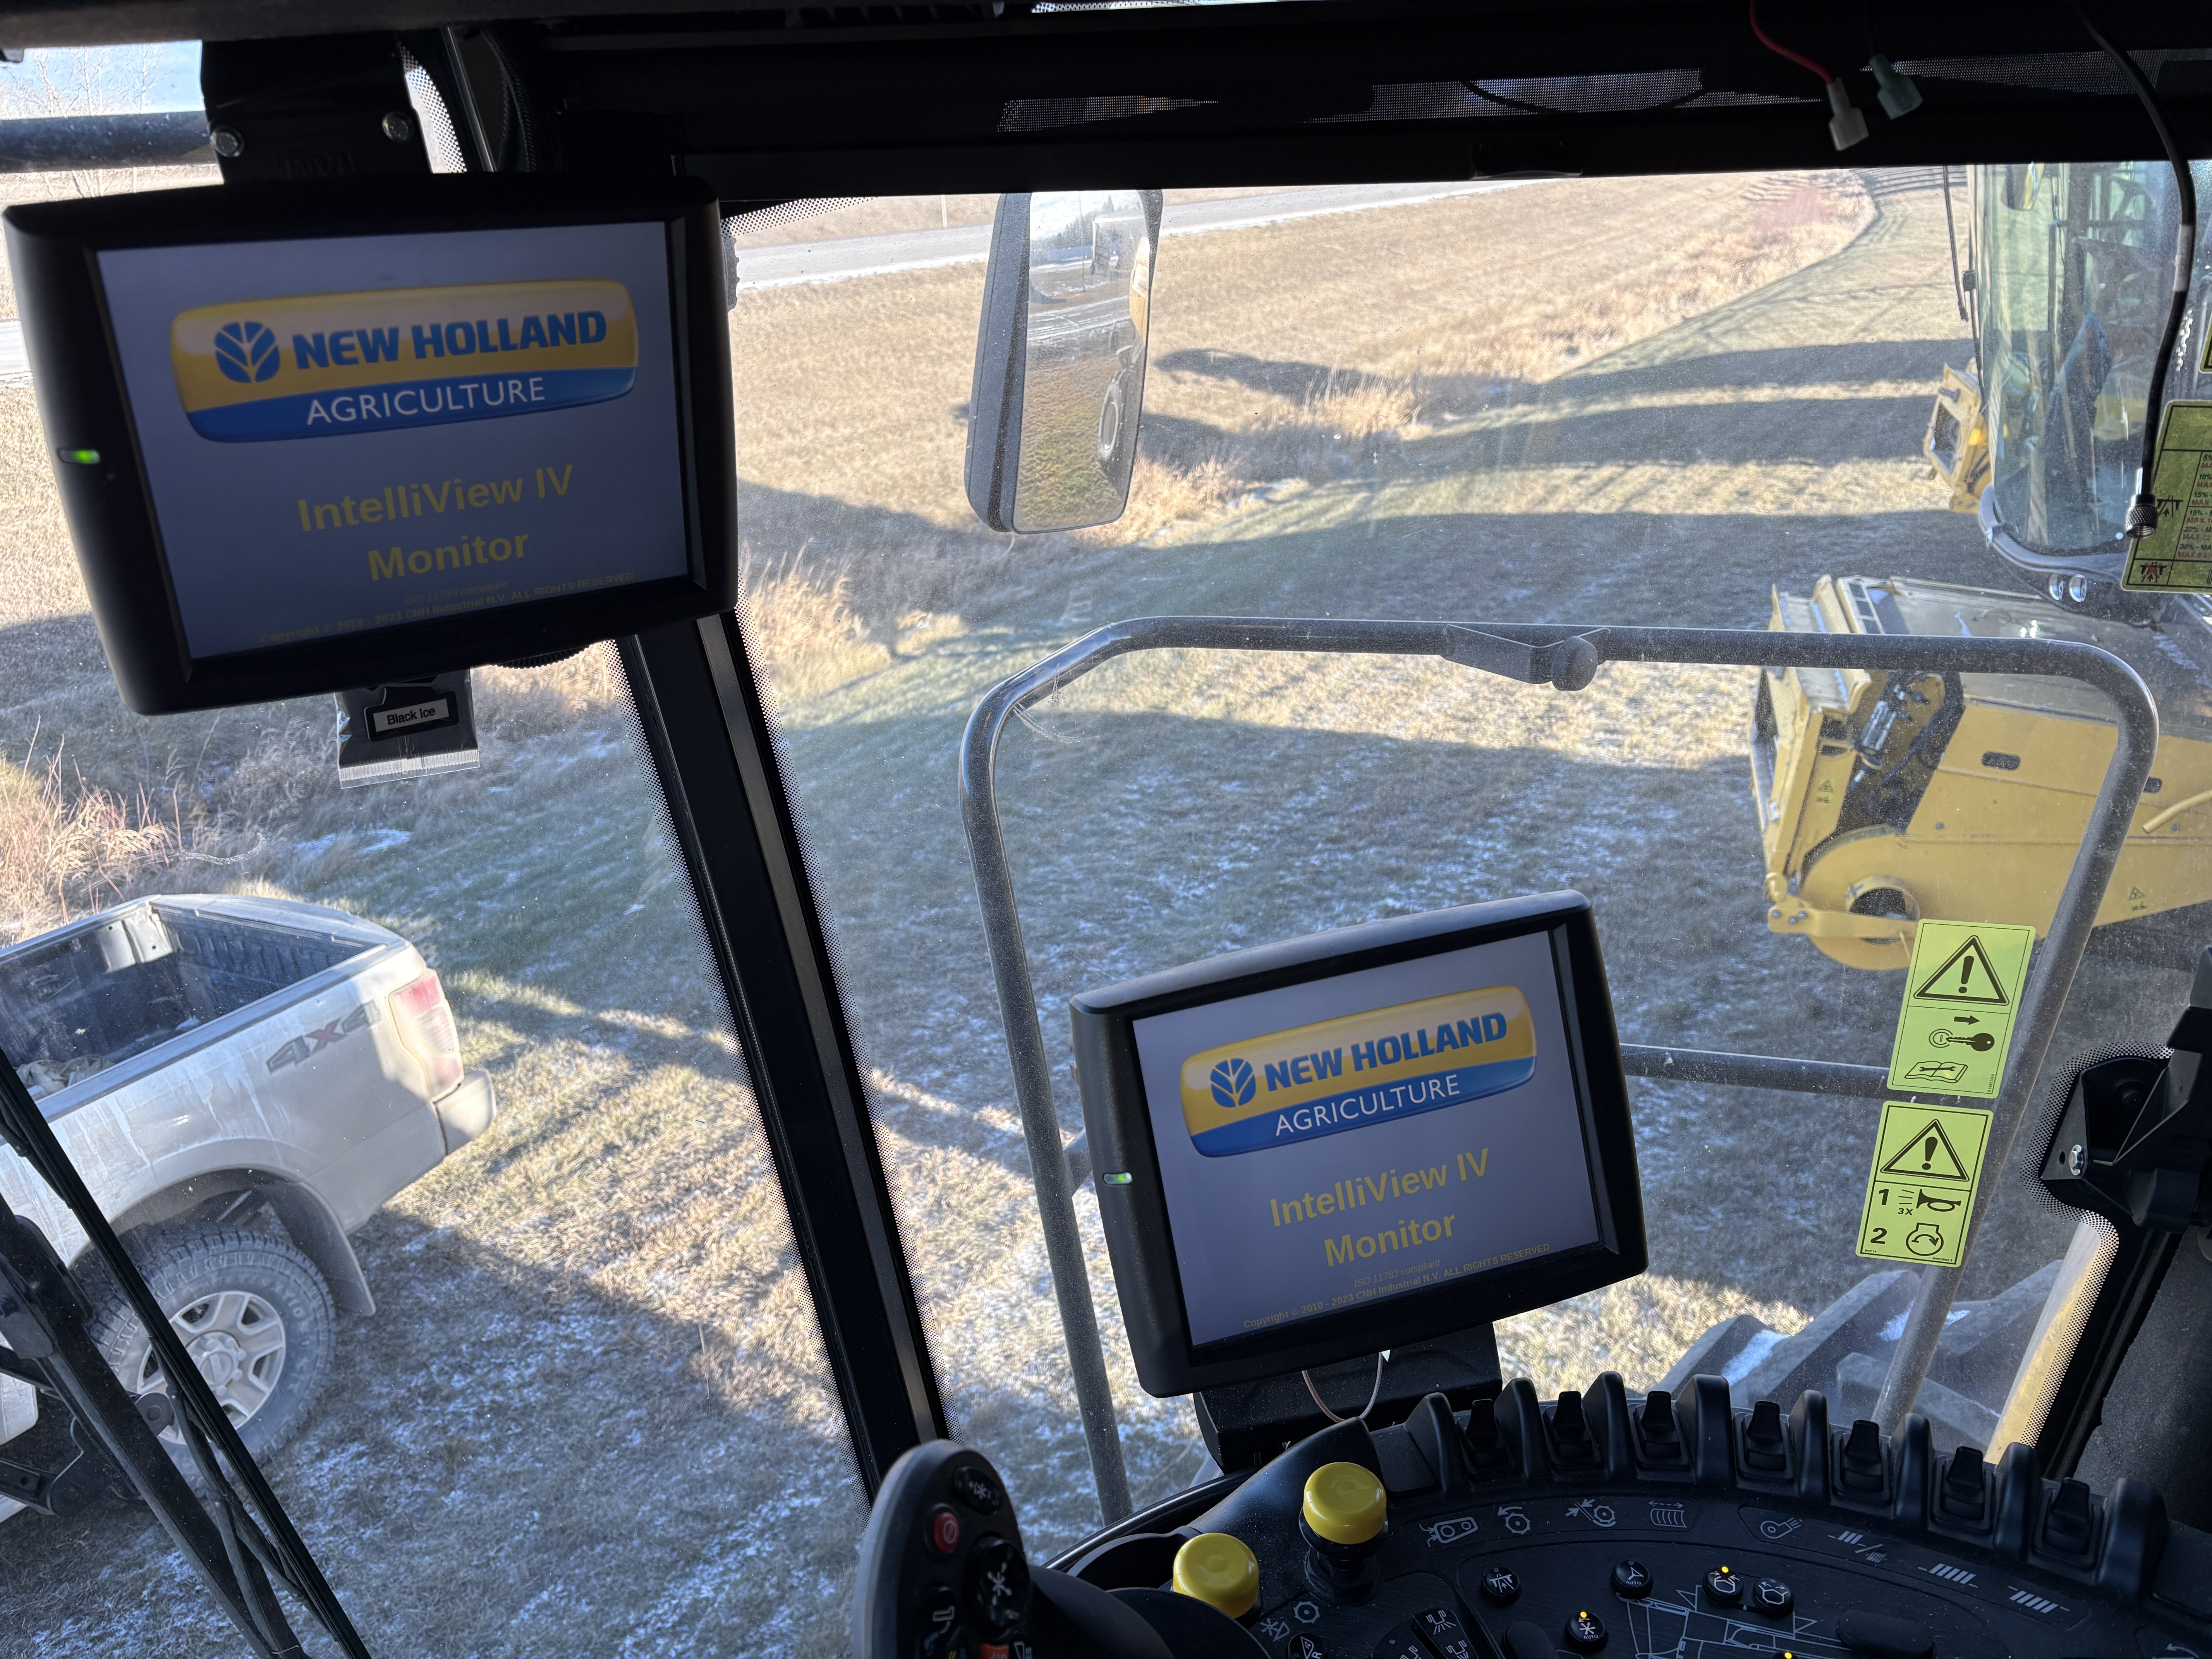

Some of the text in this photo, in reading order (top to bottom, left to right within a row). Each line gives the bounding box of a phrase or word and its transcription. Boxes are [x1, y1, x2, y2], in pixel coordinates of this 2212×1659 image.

[292, 311, 606, 369] NEW HOLLAND
[307, 377, 545, 425] AGRICULTURE
[298, 464, 573, 531] IntelliView IV
[368, 534, 529, 580] Monitor
[405, 607, 430, 618] CNH
[433, 597, 484, 614] Industrial
[511, 591, 532, 601] ALL
[534, 582, 575, 596] RIGHTS
[577, 572, 634, 589] RESERVED
[461, 581, 508, 596] compliant
[387, 707, 436, 725] Black Ice
[1264, 1012, 1507, 1092] NEW HOLLAND
[1276, 1074, 1460, 1136] AGRICULTURE
[1270, 1148, 1489, 1227] IntelliView IV
[1878, 1189, 1889, 1206] 1
[1897, 1207, 1913, 1216] 3X
[1324, 1214, 1455, 1267] Monitor
[1870, 1227, 1887, 1245] 2
[1243, 1310, 1289, 1328] Copyright
[1301, 1301, 1323, 1314] 2010
[1331, 1294, 1354, 1307] 2023
[1356, 1288, 1376, 1300] CNH
[1378, 1278, 1421, 1295] Industrial
[1423, 1271, 1441, 1283] N.V.
[1444, 1267, 1462, 1278] ALL
[1463, 1256, 1499, 1273] RIGHTS
[1500, 1243, 1550, 1263] RESERVED
[1355, 1259, 1440, 1288] ISO 11783 compliant
